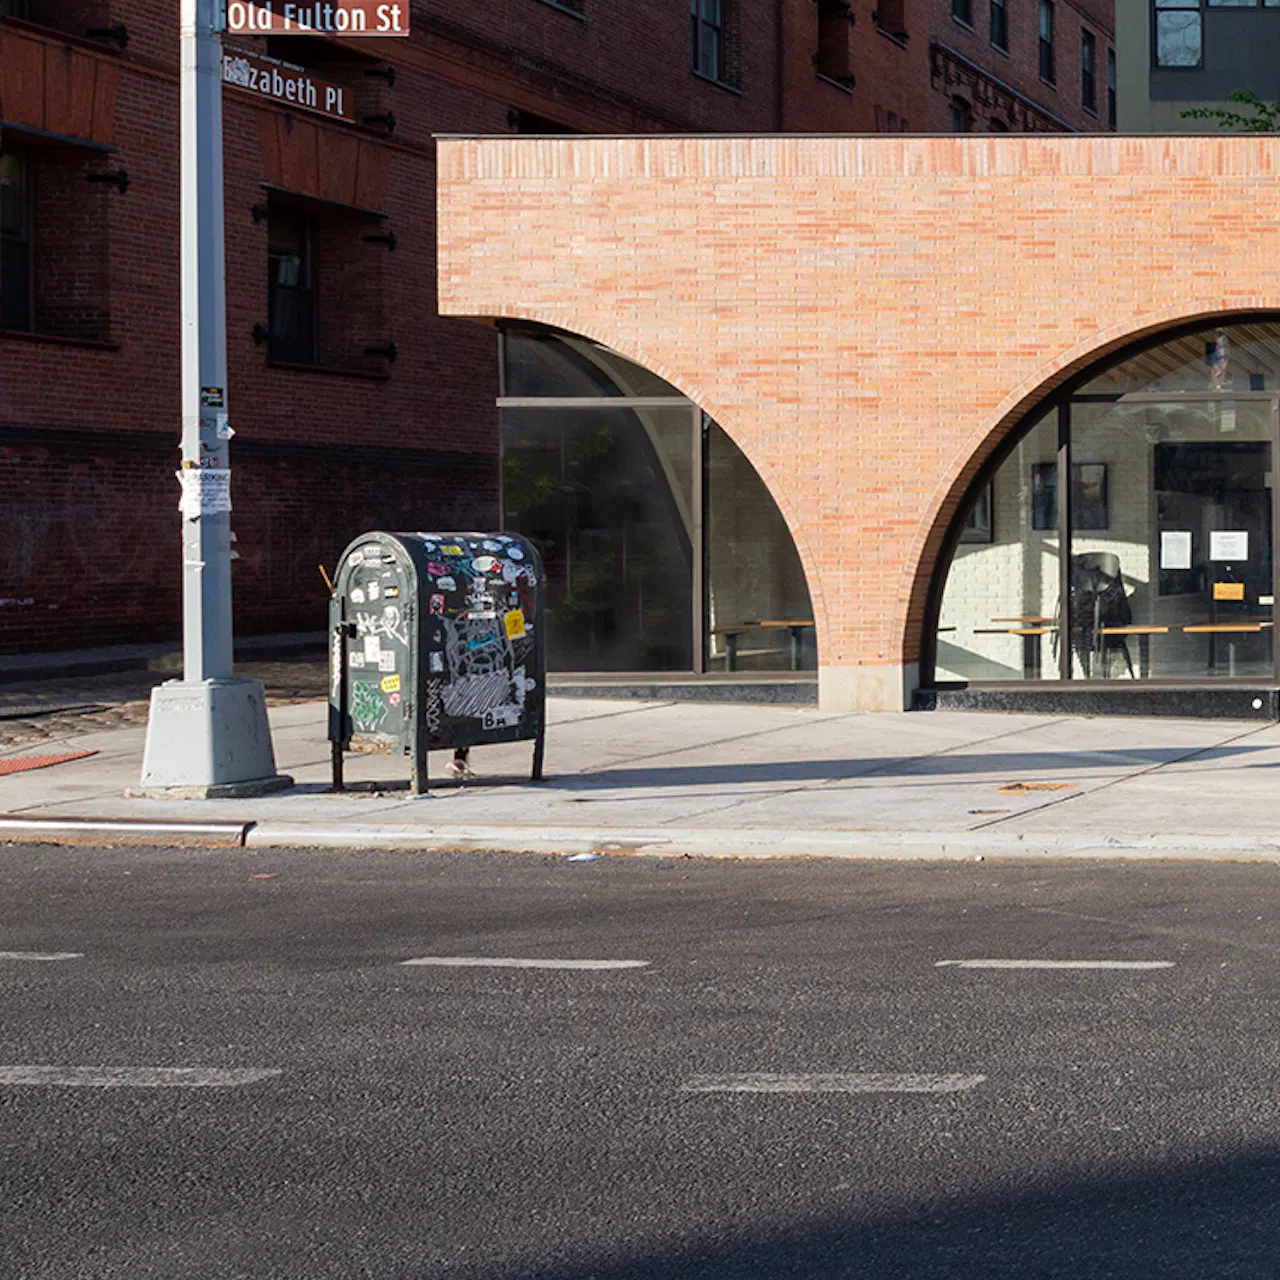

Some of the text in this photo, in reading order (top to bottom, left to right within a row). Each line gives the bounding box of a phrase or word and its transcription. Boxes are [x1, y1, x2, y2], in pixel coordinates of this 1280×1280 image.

[228, 1, 401, 32] Old Fulton St
[325, 86, 344, 115] Pl
